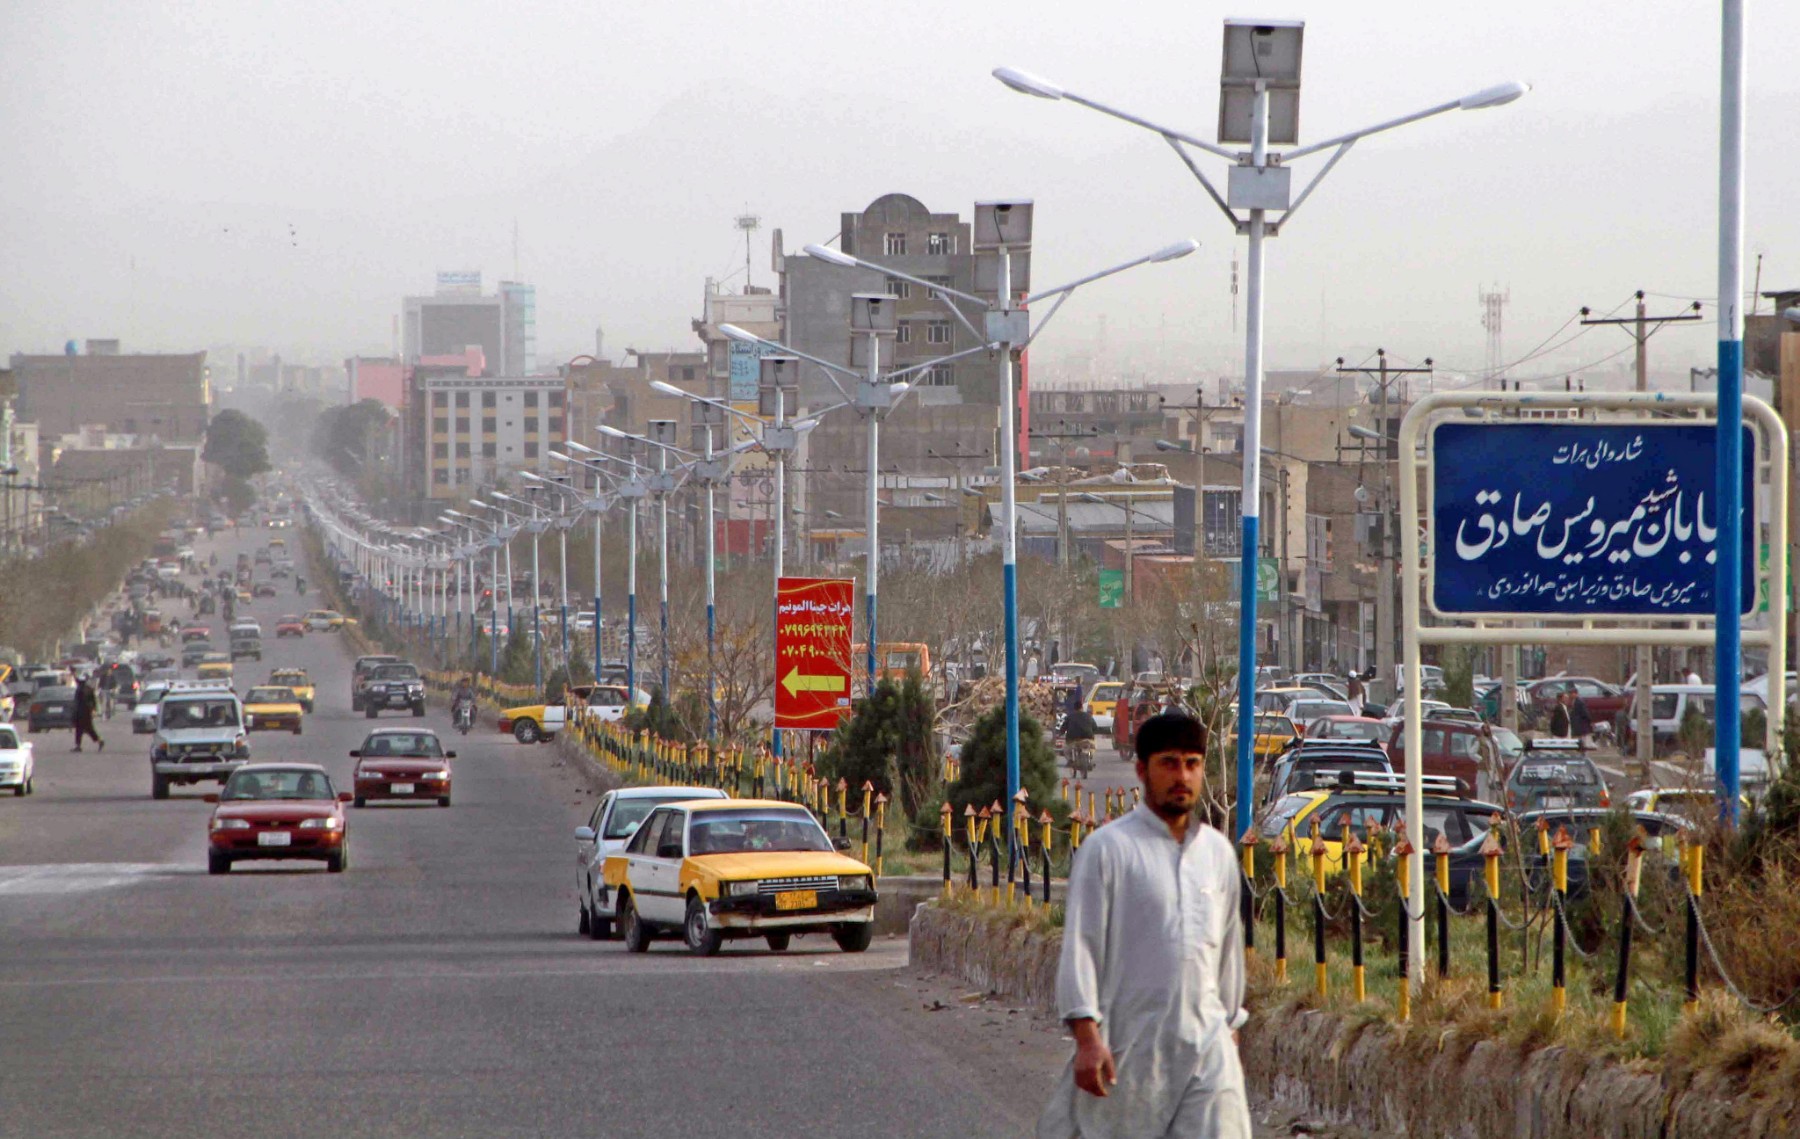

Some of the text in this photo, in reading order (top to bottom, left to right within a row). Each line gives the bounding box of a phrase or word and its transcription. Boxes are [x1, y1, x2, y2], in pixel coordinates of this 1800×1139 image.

[1552, 434, 1643, 470] شاروالی هرات
[1640, 468, 1678, 513] شهید
[1455, 489, 1551, 561] صادق
[1536, 496, 1646, 565] میرویس
[1554, 574, 1584, 602] اسبق
[1581, 575, 1609, 604] وزیر
[1609, 574, 1652, 600] صادق
[1650, 582, 1696, 607] میرویس
[827, 600, 852, 616] هرات
